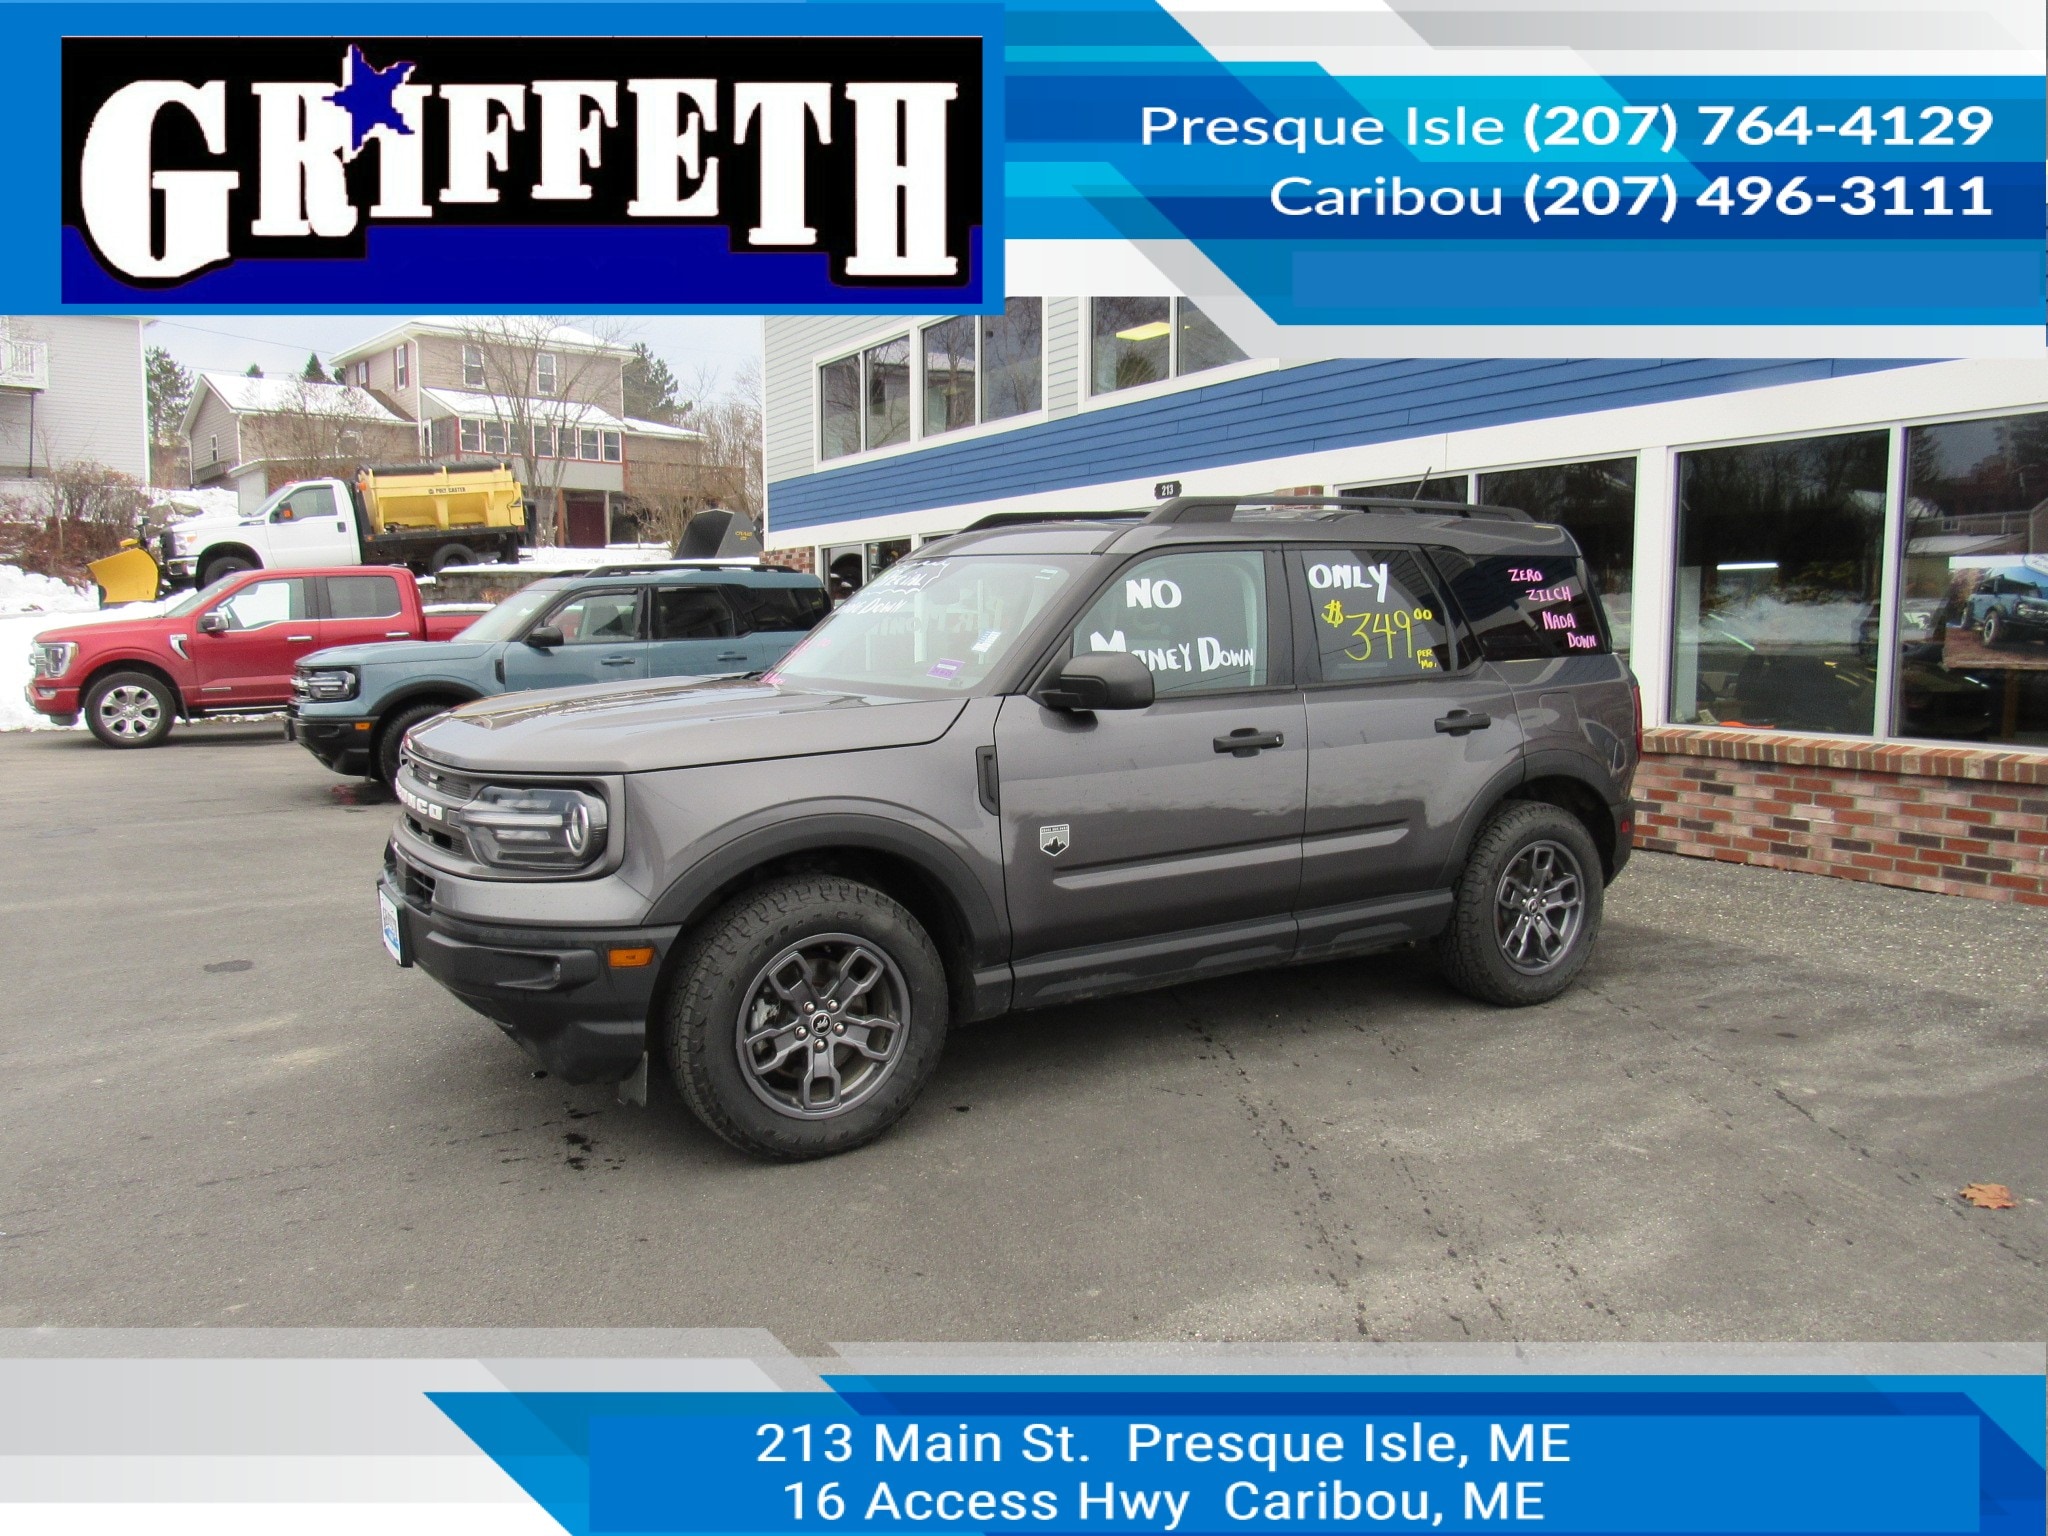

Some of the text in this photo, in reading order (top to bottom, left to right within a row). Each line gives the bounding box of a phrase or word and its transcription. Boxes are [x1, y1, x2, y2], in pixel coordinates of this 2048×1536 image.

[1161, 484, 1174, 496] 213
[1507, 568, 1543, 582] ZERO
[1308, 563, 1388, 604] ONLY
[1126, 578, 1182, 609] NO
[1525, 586, 1572, 602] ZILCH
[1542, 611, 1577, 631] NADA
[1566, 632, 1597, 649] DOWN
[1416, 648, 1434, 664] PER
